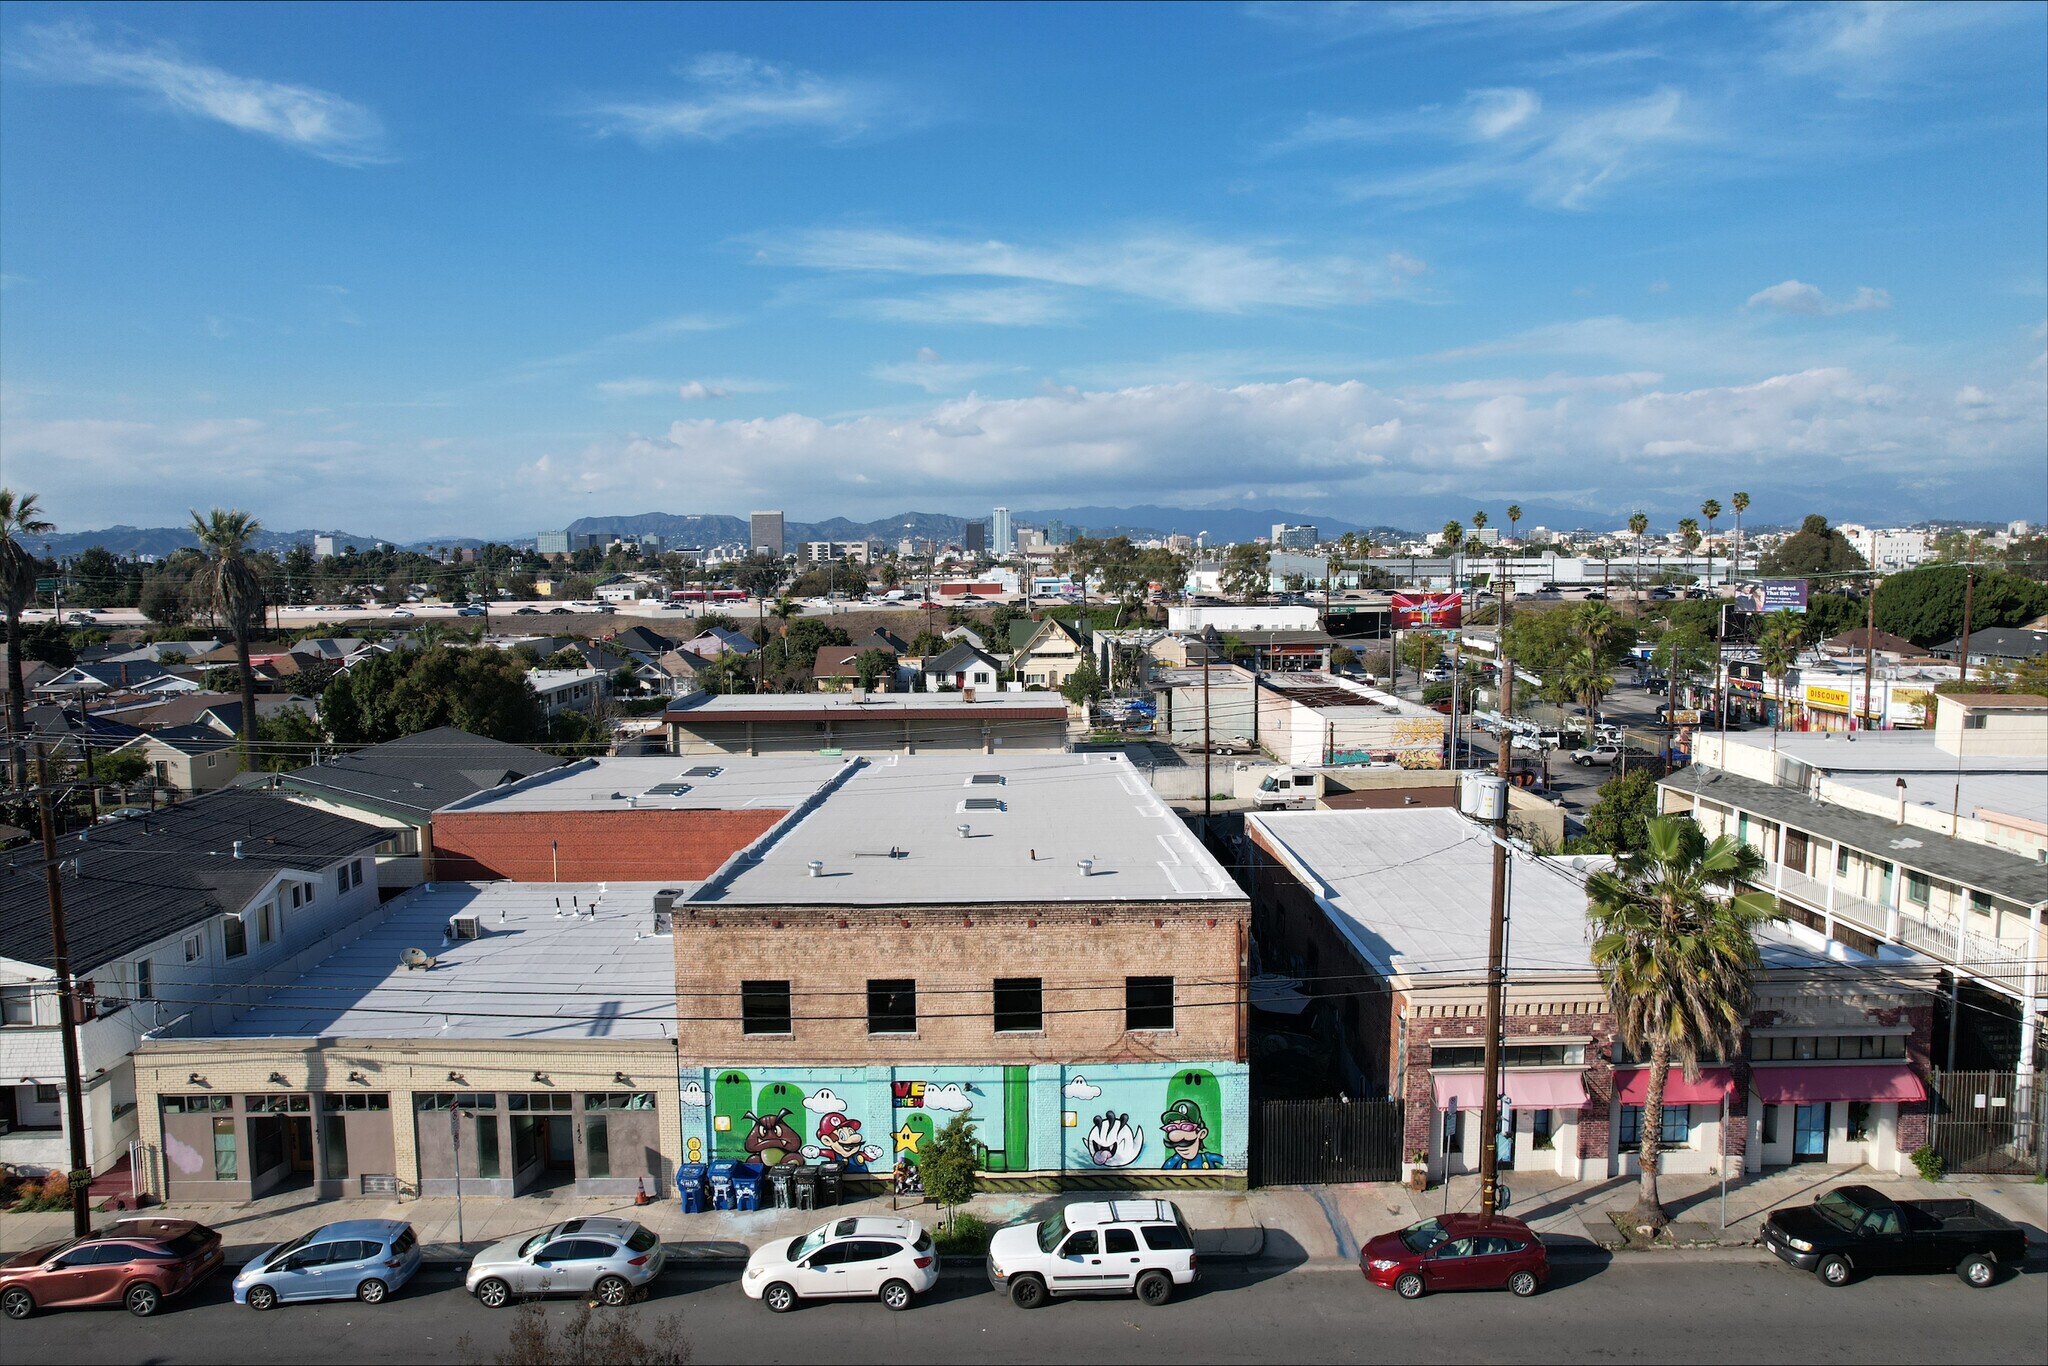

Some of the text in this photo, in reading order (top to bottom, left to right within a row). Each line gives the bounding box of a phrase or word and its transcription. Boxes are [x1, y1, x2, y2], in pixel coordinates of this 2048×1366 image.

[1810, 689, 1845, 701] DISCOUNT
[1856, 693, 1877, 703] DISCNT
[69, 1168, 91, 1181] DRIVE
